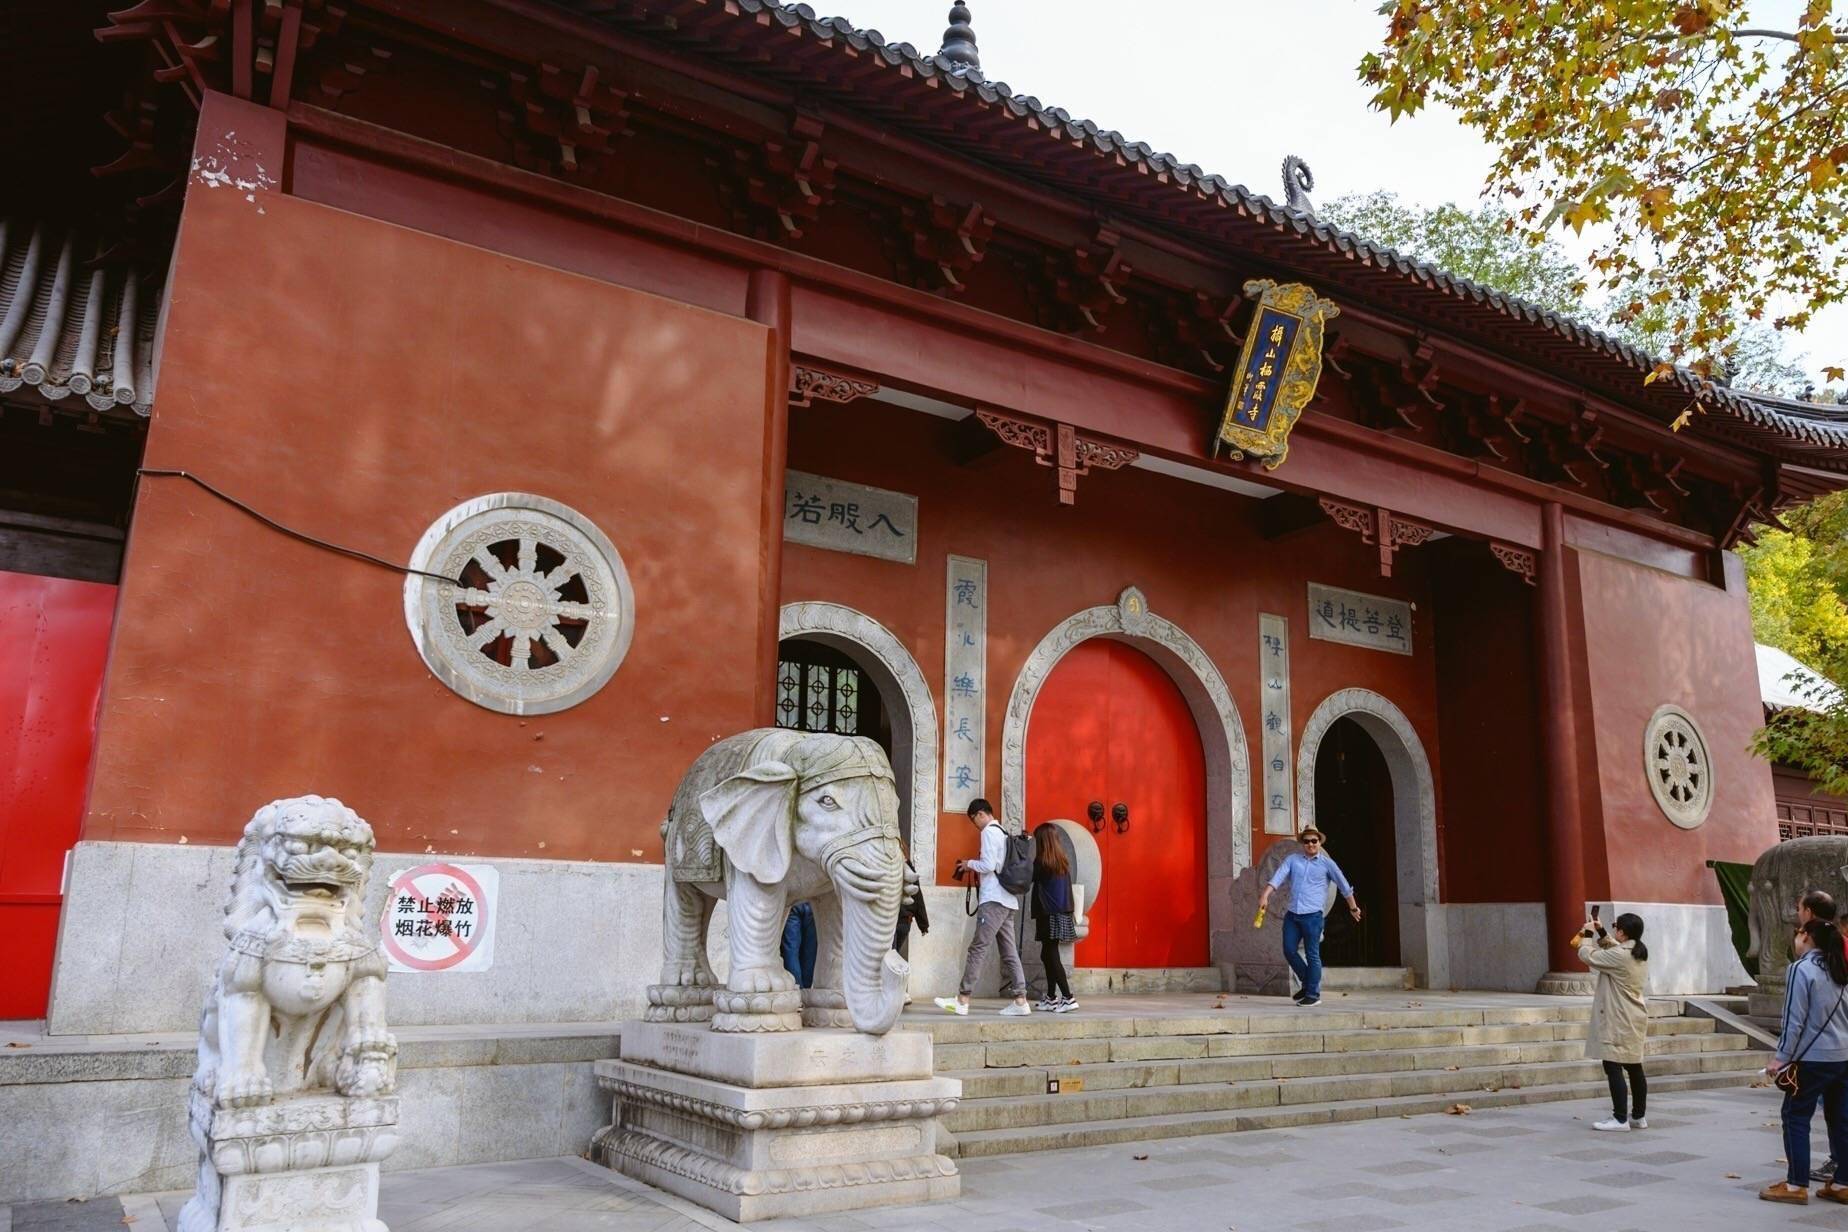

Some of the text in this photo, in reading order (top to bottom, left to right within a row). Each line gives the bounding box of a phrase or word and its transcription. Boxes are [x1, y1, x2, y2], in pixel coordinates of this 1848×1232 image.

[784, 490, 905, 537] 入般若
[397, 895, 474, 914] 禁止燃放
[394, 919, 472, 938] 烟花爆竹
